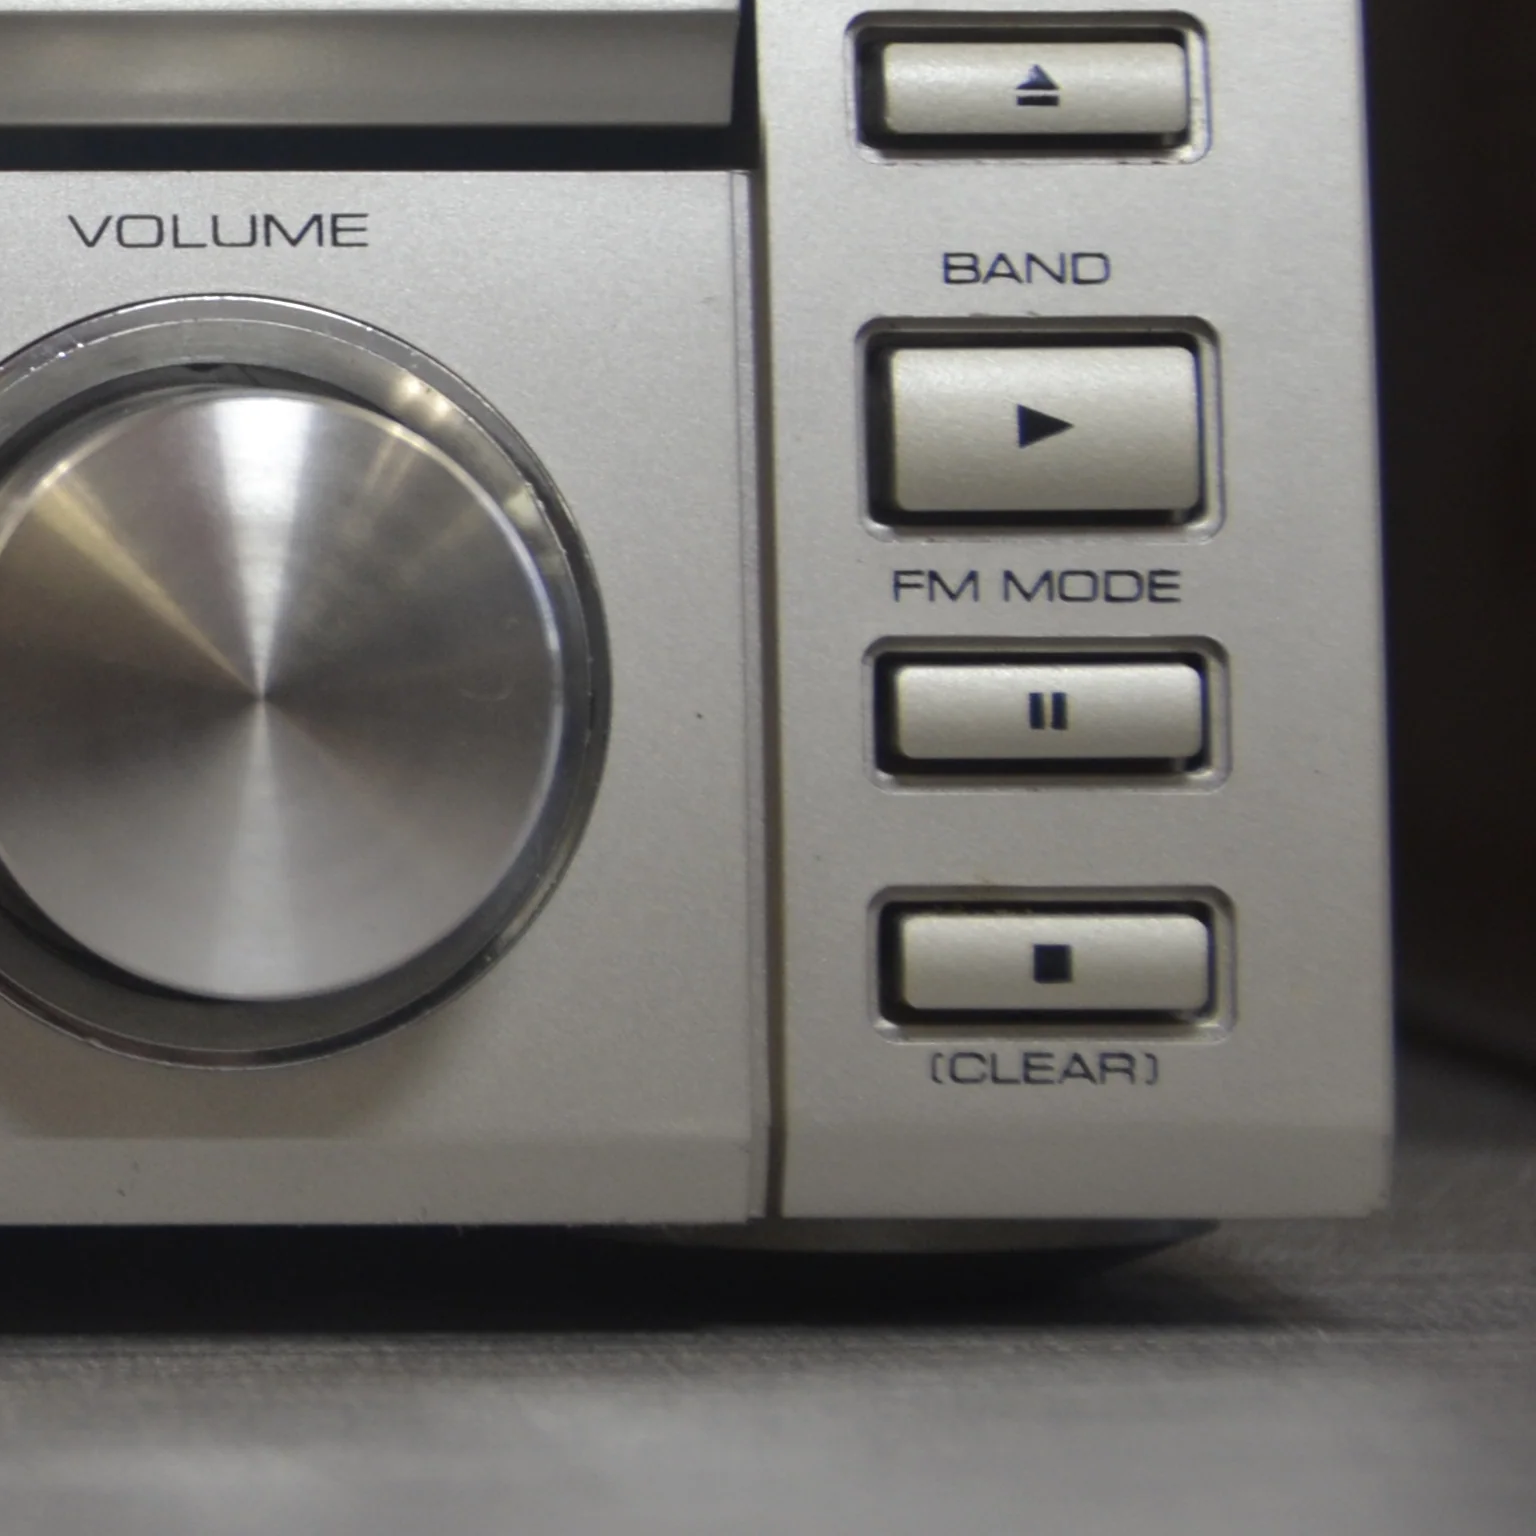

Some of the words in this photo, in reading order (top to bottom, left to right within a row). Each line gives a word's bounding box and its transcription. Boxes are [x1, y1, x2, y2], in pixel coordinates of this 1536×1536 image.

[67, 212, 369, 249] VOLUME
[942, 251, 1111, 286] BAND
[892, 569, 980, 602] FM
[1002, 568, 1181, 604] MODE
[930, 1051, 1159, 1086] (CLEAR)
